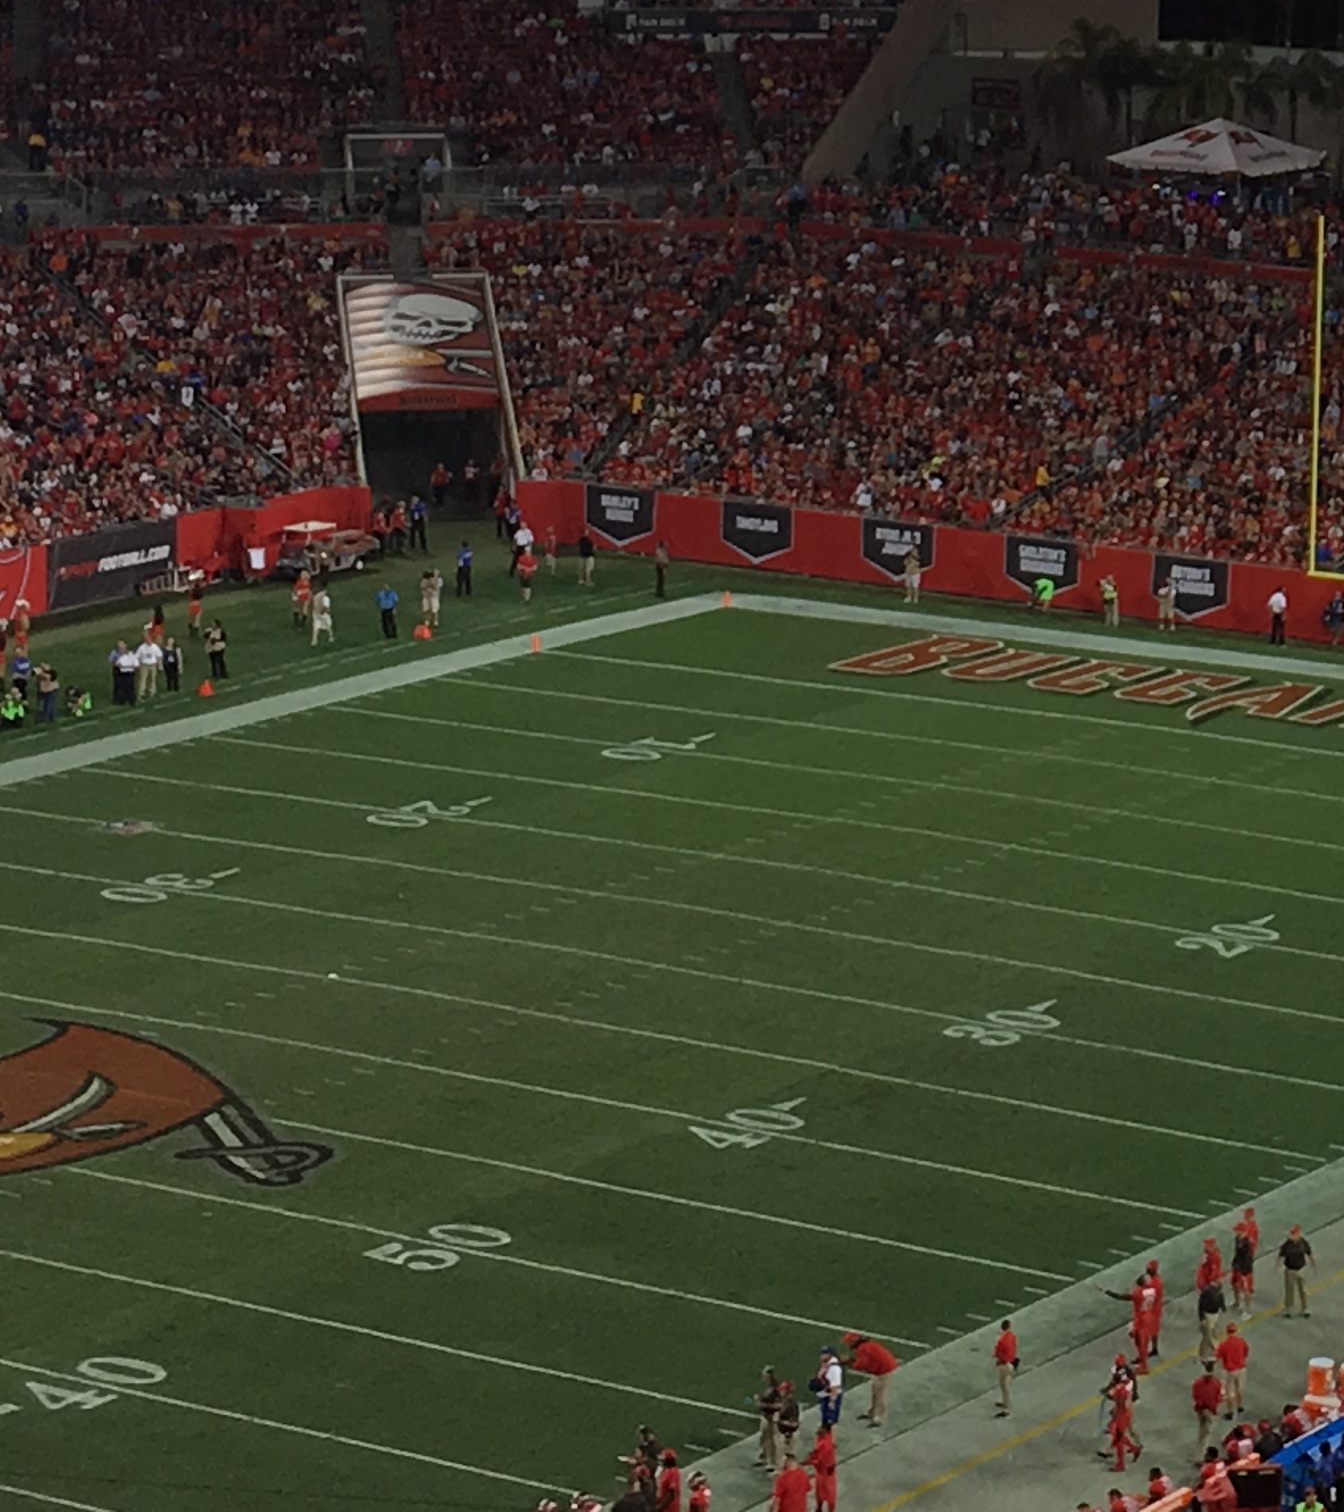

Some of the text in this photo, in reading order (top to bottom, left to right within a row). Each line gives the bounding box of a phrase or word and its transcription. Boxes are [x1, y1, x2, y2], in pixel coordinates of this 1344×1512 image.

[1174, 920, 1281, 959] 20
[942, 1006, 1062, 1048] 30
[687, 1105, 806, 1151] 40
[361, 1222, 513, 1272] 50
[23, 1354, 168, 1412] 40
